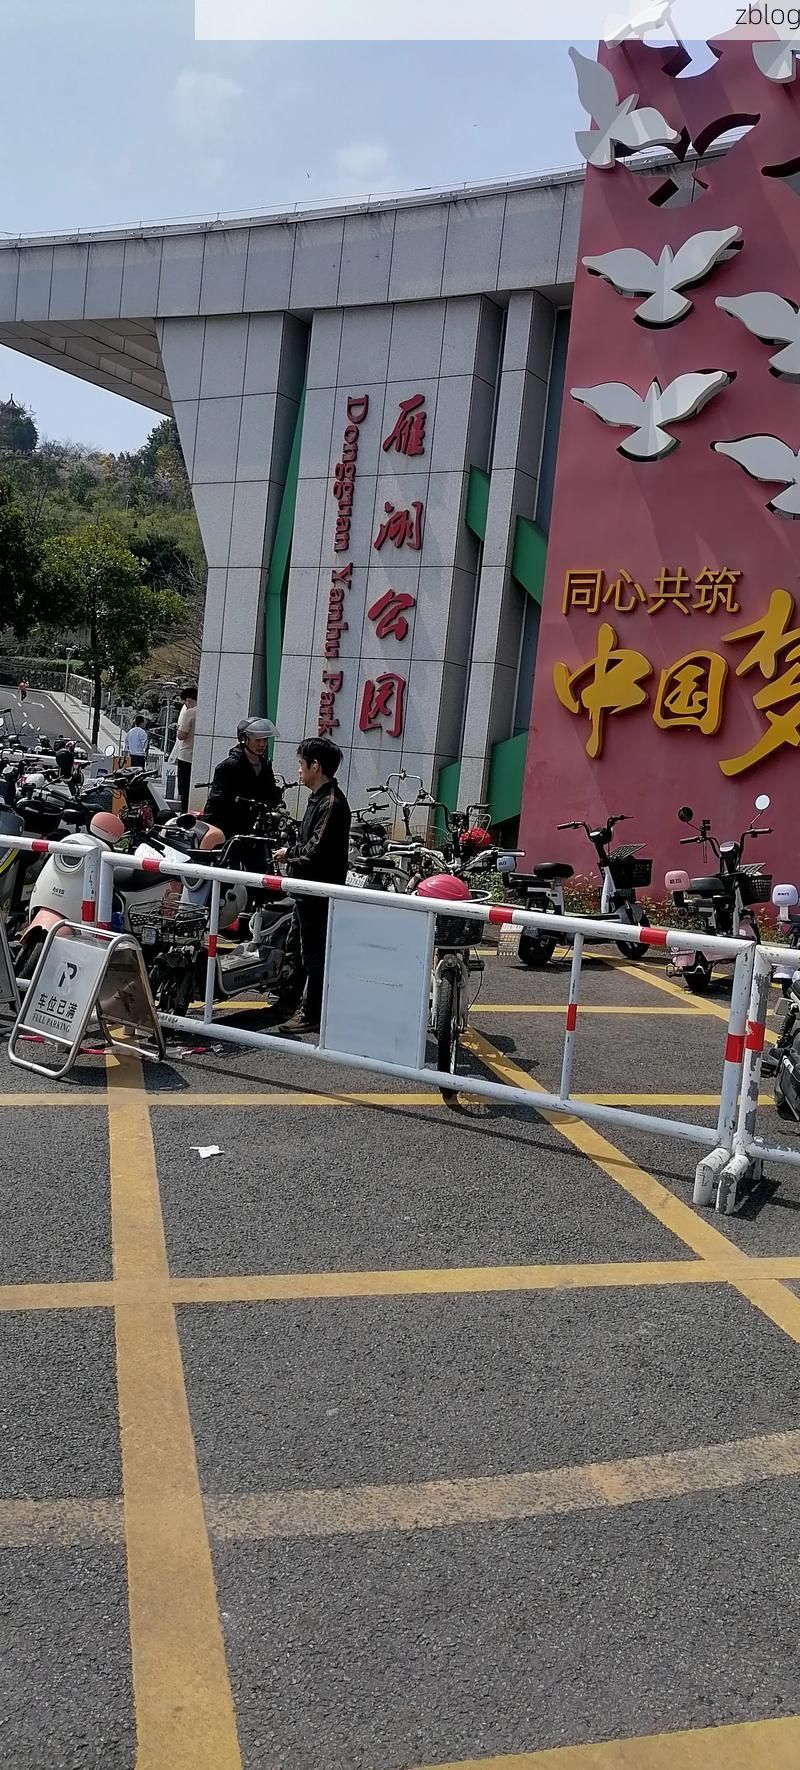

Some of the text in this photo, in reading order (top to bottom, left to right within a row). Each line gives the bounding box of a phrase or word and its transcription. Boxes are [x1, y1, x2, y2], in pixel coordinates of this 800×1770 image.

[316, 394, 369, 737] Dongguan Yanhu Park
[359, 394, 426, 738] 雁湖公园
[562, 566, 743, 616] 同心共筑
[32, 1012, 72, 1033] FULL PARKING
[37, 993, 78, 1020] 车位已满
